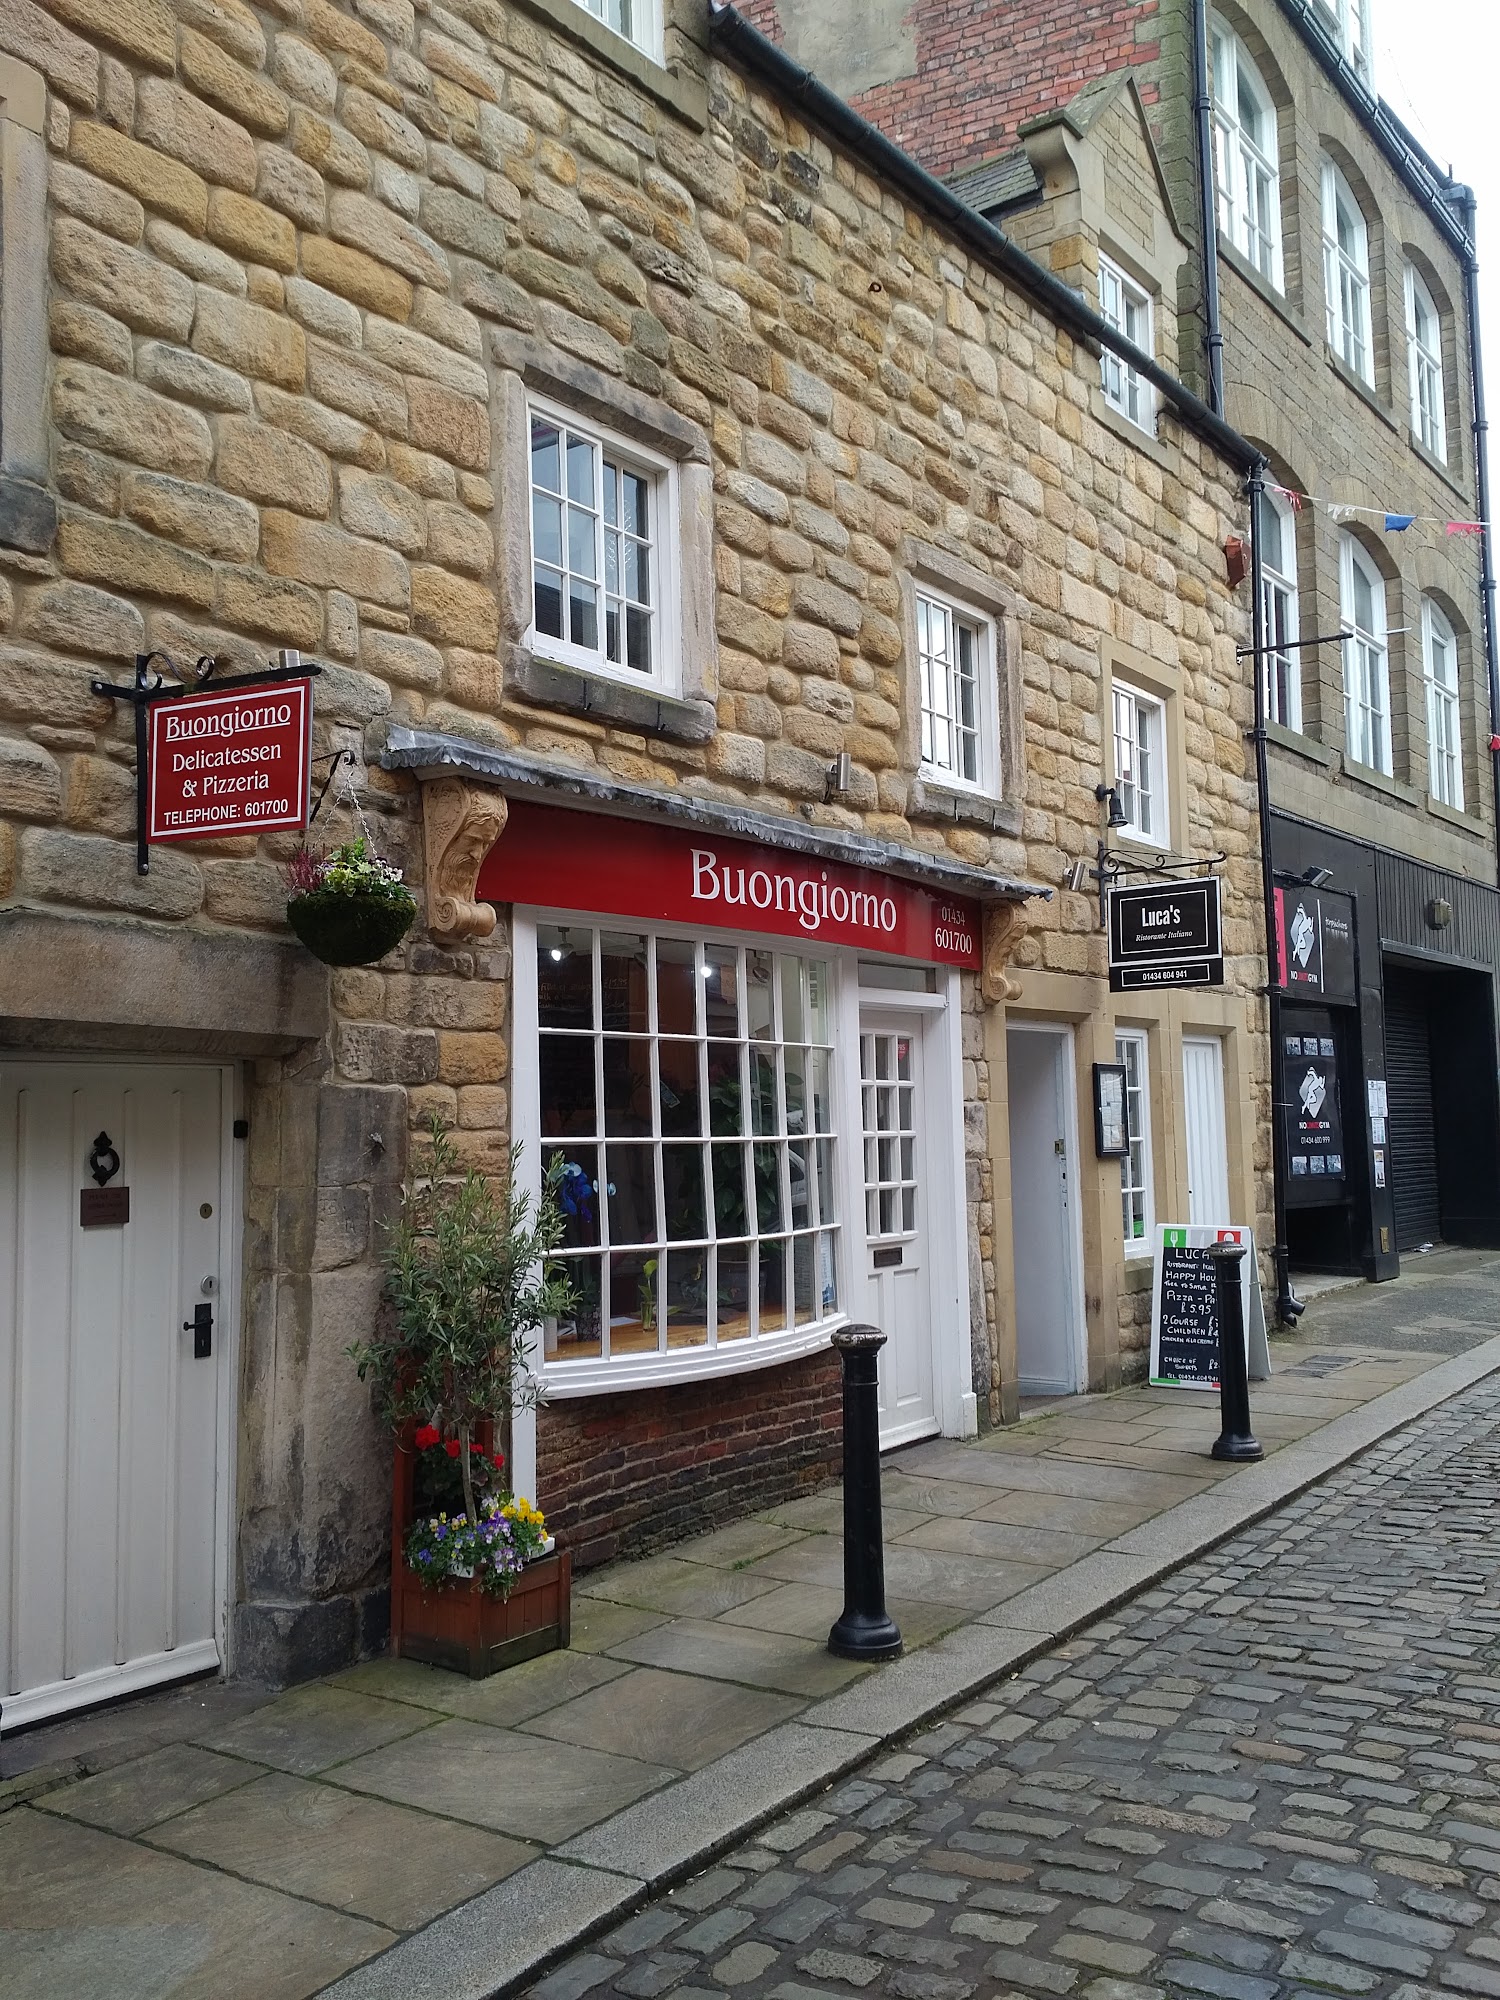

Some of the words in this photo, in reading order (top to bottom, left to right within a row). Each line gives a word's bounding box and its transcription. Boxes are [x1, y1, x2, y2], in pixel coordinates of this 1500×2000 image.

[166, 704, 291, 740] Buongiorno
[172, 744, 281, 772] Delicatessen
[182, 779, 197, 798] &
[203, 770, 269, 795] Pizzeria
[164, 805, 241, 825] TELEPHONE:
[245, 799, 288, 817] 601700
[690, 848, 896, 932] Buongiorno
[941, 906, 965, 926] 01434
[1141, 905, 1181, 927] Luca's
[935, 927, 972, 954] 601700
[1135, 933, 1167, 941] Ristorante
[1168, 930, 1193, 939] Italiano
[1142, 972, 1161, 980] 01434
[1163, 971, 1174, 979] 604
[1175, 970, 1187, 978] 941
[1175, 1249, 1212, 1260] LUCA
[1165, 1270, 1195, 1280] HAPPY
[1200, 1272, 1216, 1281] HOU
[1166, 1290, 1193, 1301] PIZZA
[1205, 1294, 1217, 1304] PA
[1167, 1326, 1206, 1335] CHILDREN
[1170, 1315, 1198, 1326] COURSE
